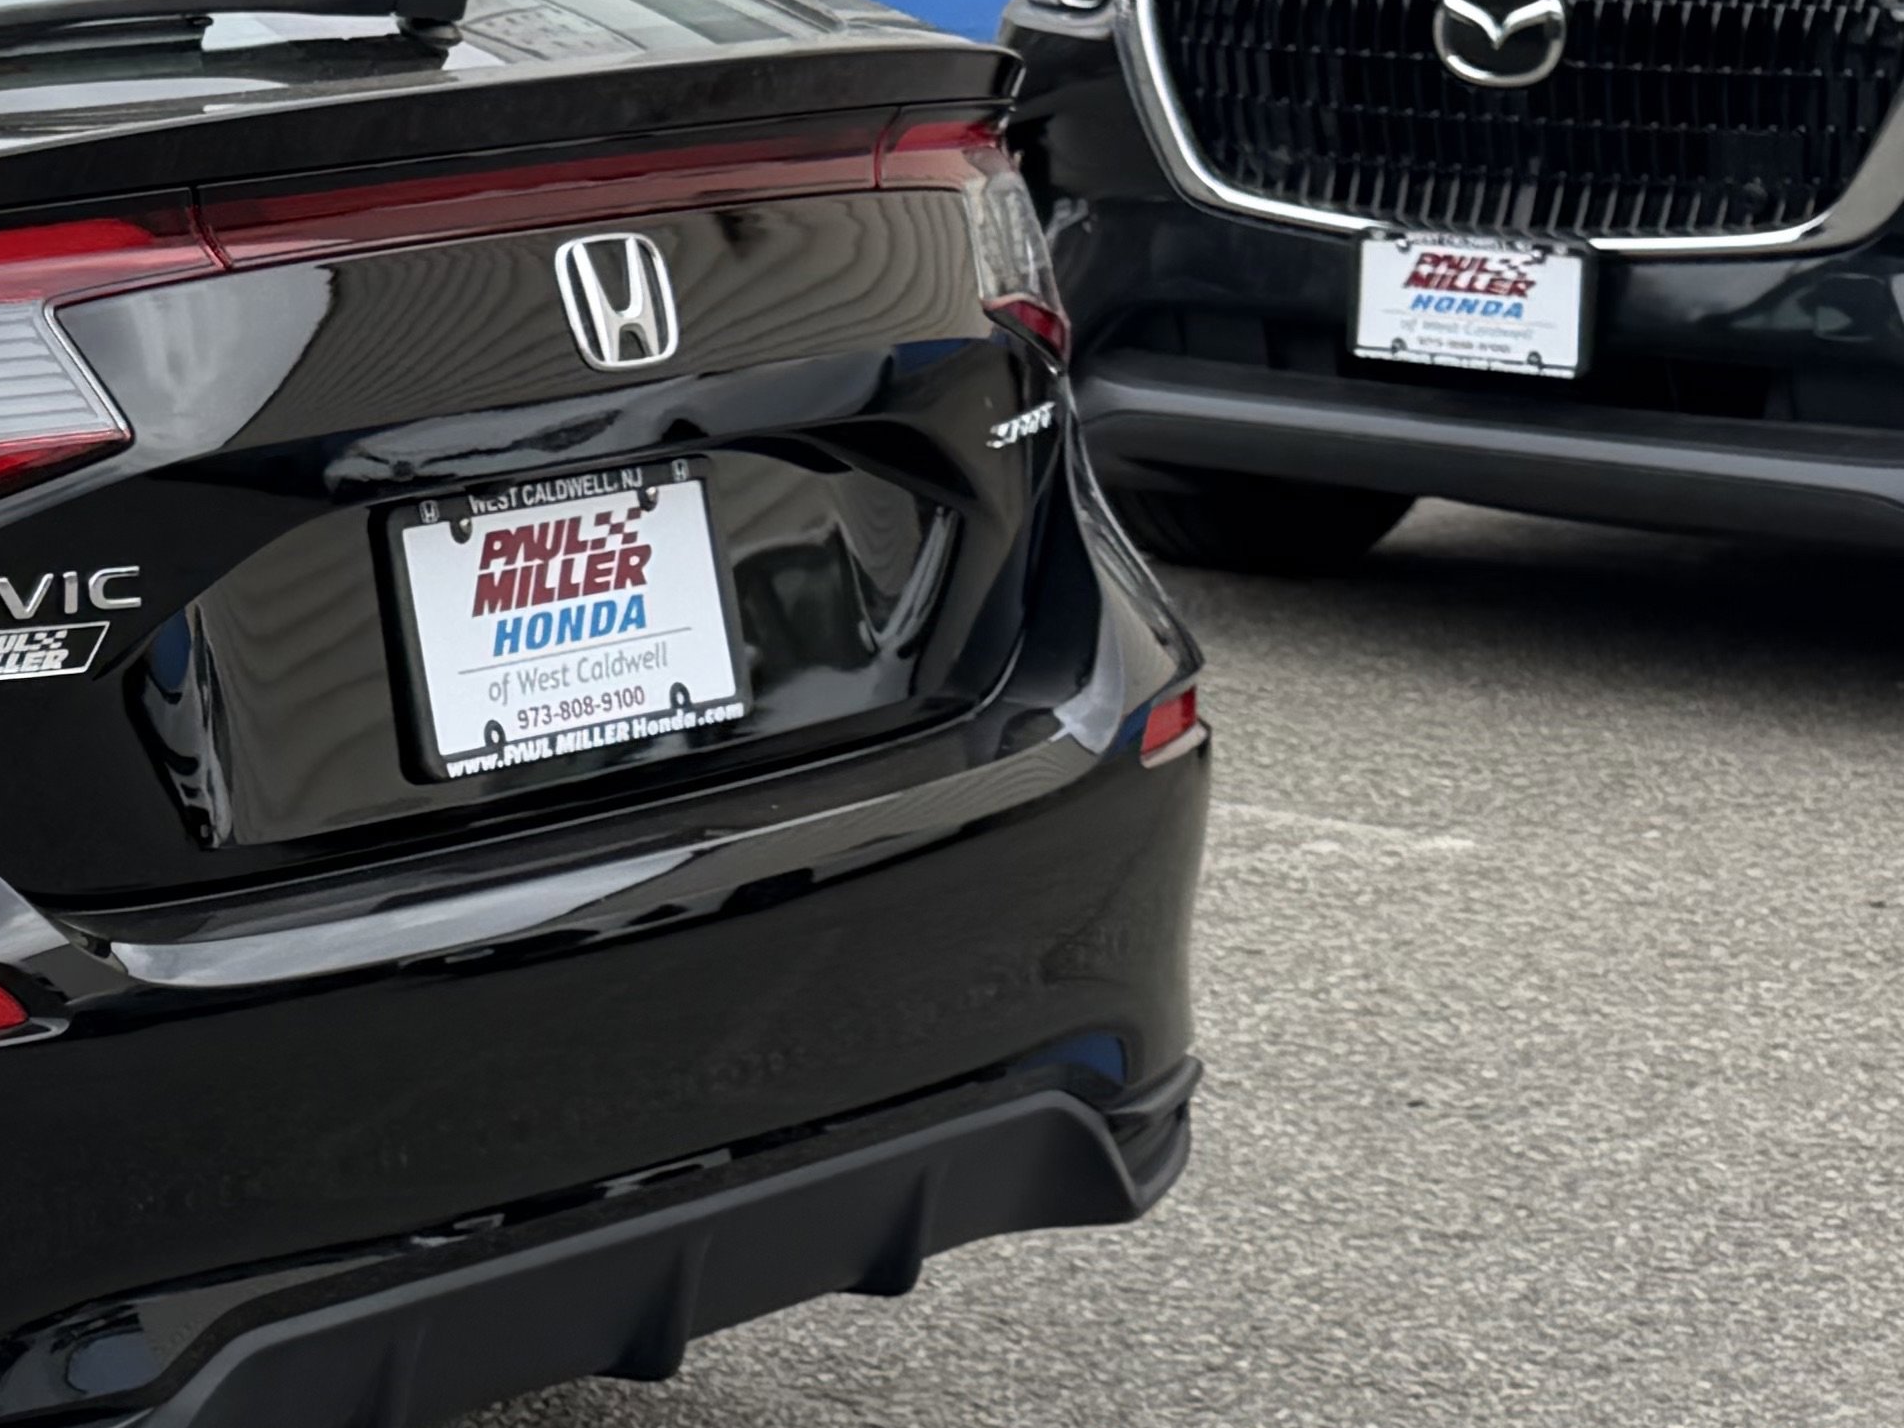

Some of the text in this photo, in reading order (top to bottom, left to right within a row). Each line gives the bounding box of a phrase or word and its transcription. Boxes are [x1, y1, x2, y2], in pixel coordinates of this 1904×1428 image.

[621, 467, 643, 490] NJ
[479, 516, 589, 570] PAUL
[472, 543, 652, 617] MILLER
[493, 593, 647, 657] HONDA
[488, 641, 668, 706] of West Caldwell
[517, 685, 646, 730] 973-808-9100
